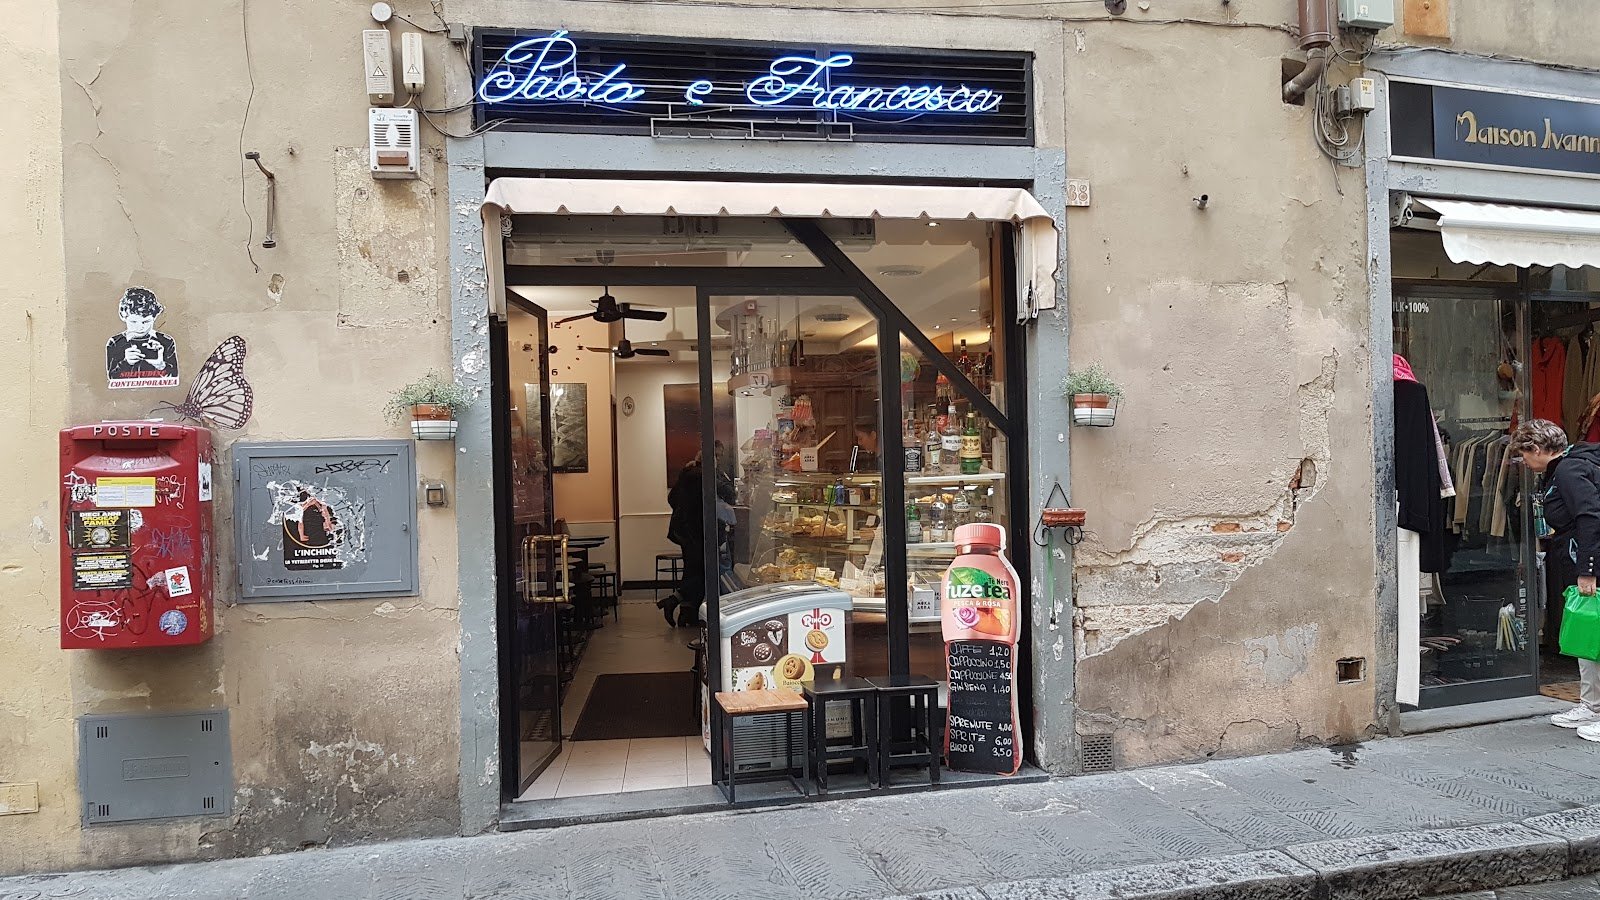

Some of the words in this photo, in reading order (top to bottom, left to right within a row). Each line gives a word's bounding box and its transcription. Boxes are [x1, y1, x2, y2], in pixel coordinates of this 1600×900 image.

[479, 30, 646, 104] Paolo
[685, 80, 714, 107] e
[746, 54, 1003, 113] Francesca
[1455, 110, 1537, 147] Maison
[110, 379, 178, 388] CONTEMPORANEA
[93, 425, 160, 436] POSTE
[83, 519, 118, 527] FAMILY
[801, 613, 832, 628] RINGO
[989, 645, 1010, 657] 1,20
[948, 655, 994, 668] CAPPUCCINO
[994, 659, 1011, 669] 1,50
[949, 729, 986, 742] SPRITZ
[994, 735, 1012, 746] 6,00
[949, 742, 975, 753] BIRRA
[991, 747, 1012, 758] 3,50
